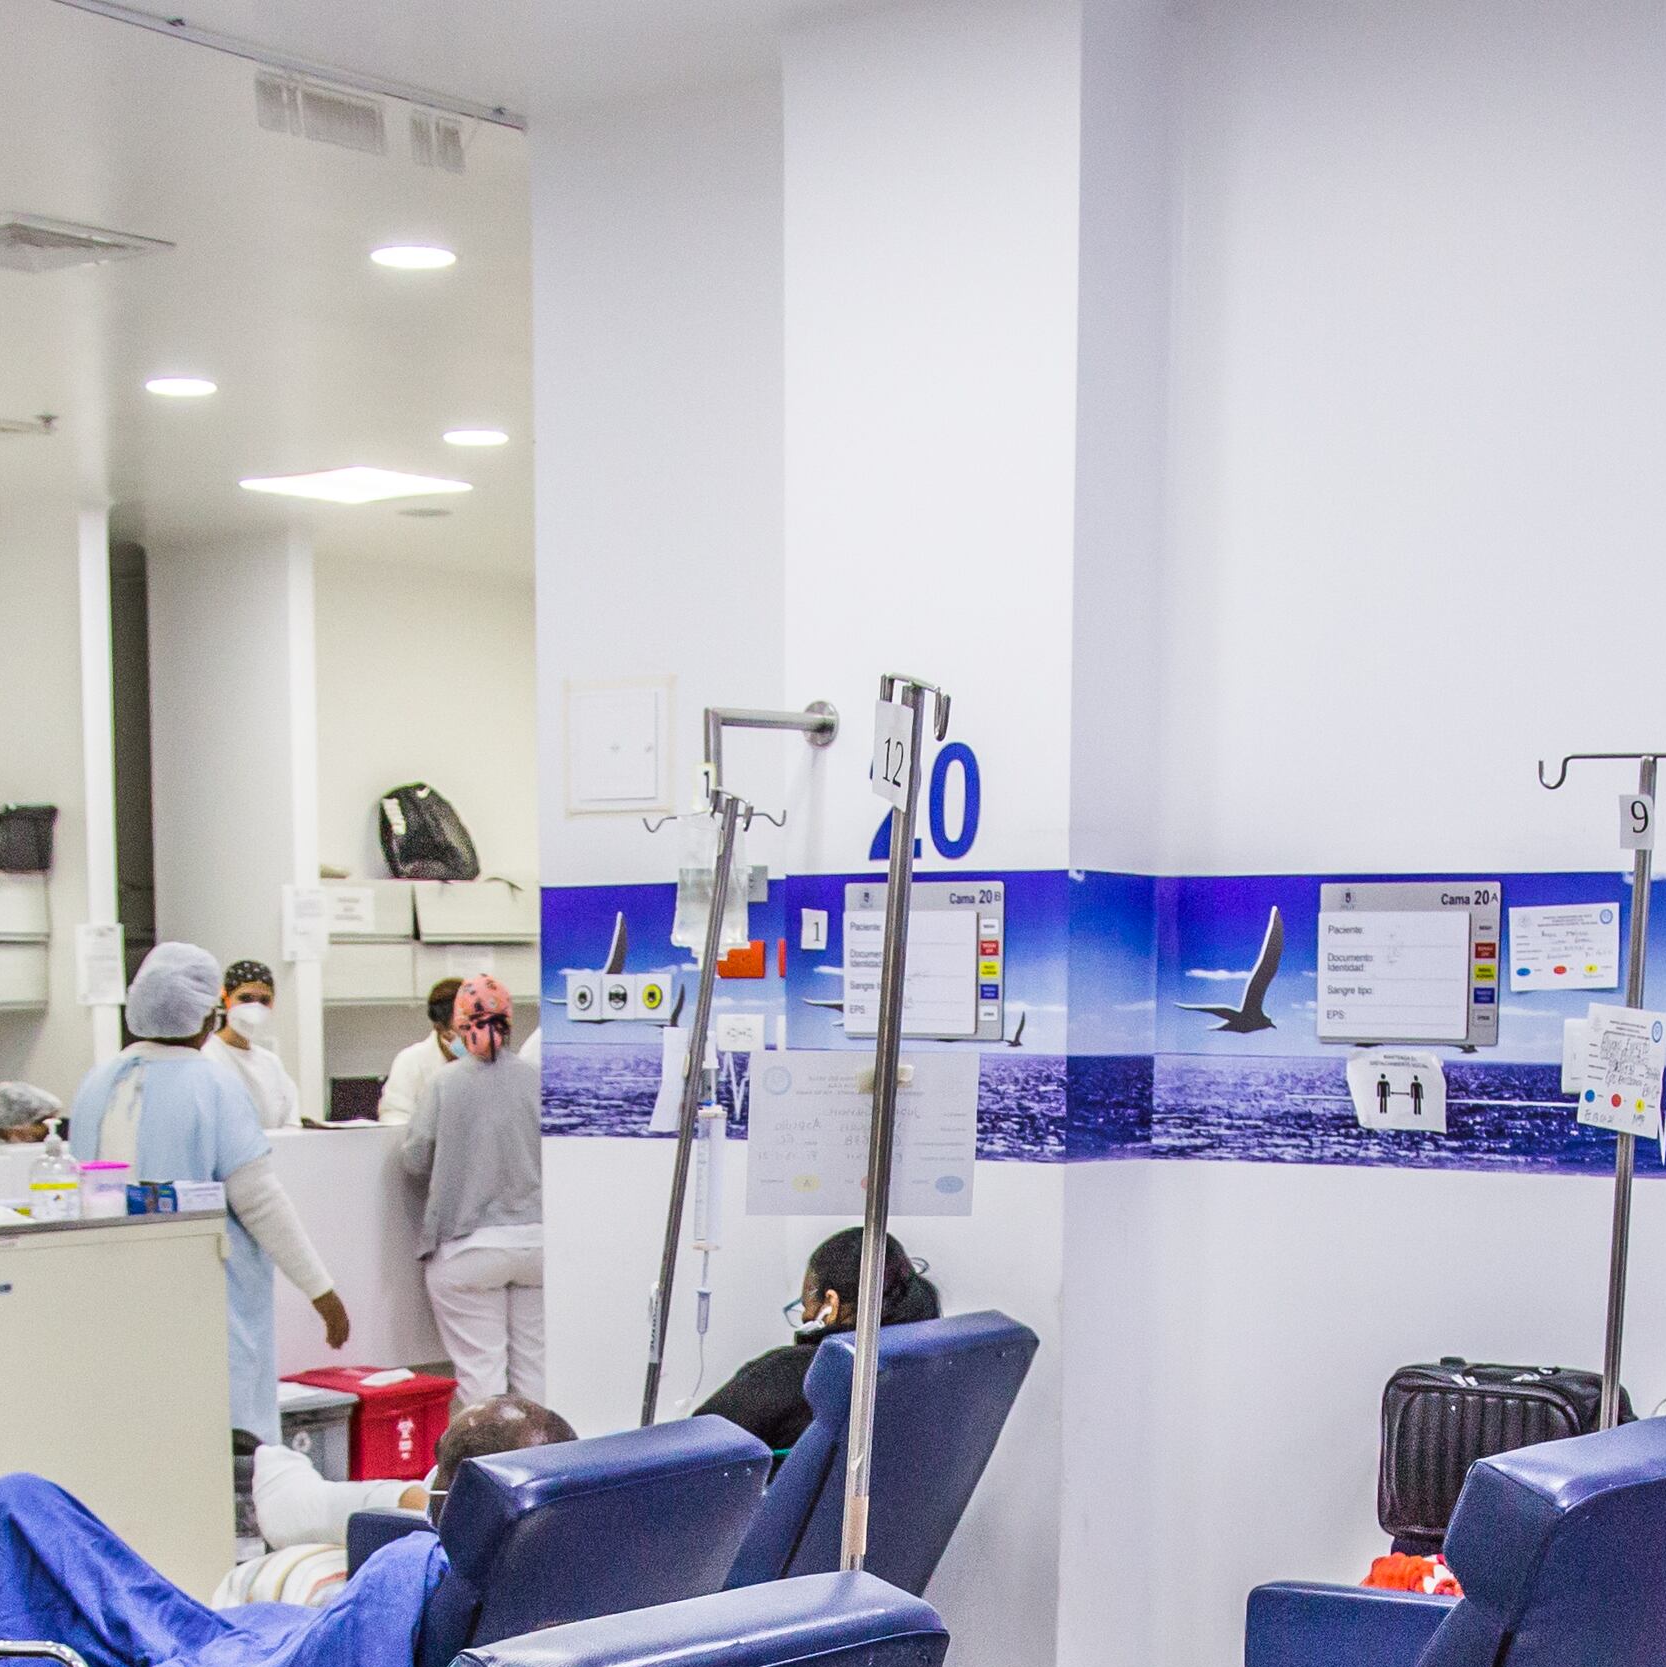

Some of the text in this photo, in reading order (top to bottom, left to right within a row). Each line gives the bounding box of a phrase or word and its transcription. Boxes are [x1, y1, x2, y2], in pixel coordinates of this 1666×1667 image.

[882, 737, 905, 788] 12
[868, 741, 981, 861] 0
[1630, 800, 1649, 834] 9
[949, 892, 976, 904] Cama
[1440, 893, 1471, 906] Cama
[812, 921, 822, 942] 1
[1327, 952, 1373, 963] Documento
[1327, 985, 1356, 997] Sangre
